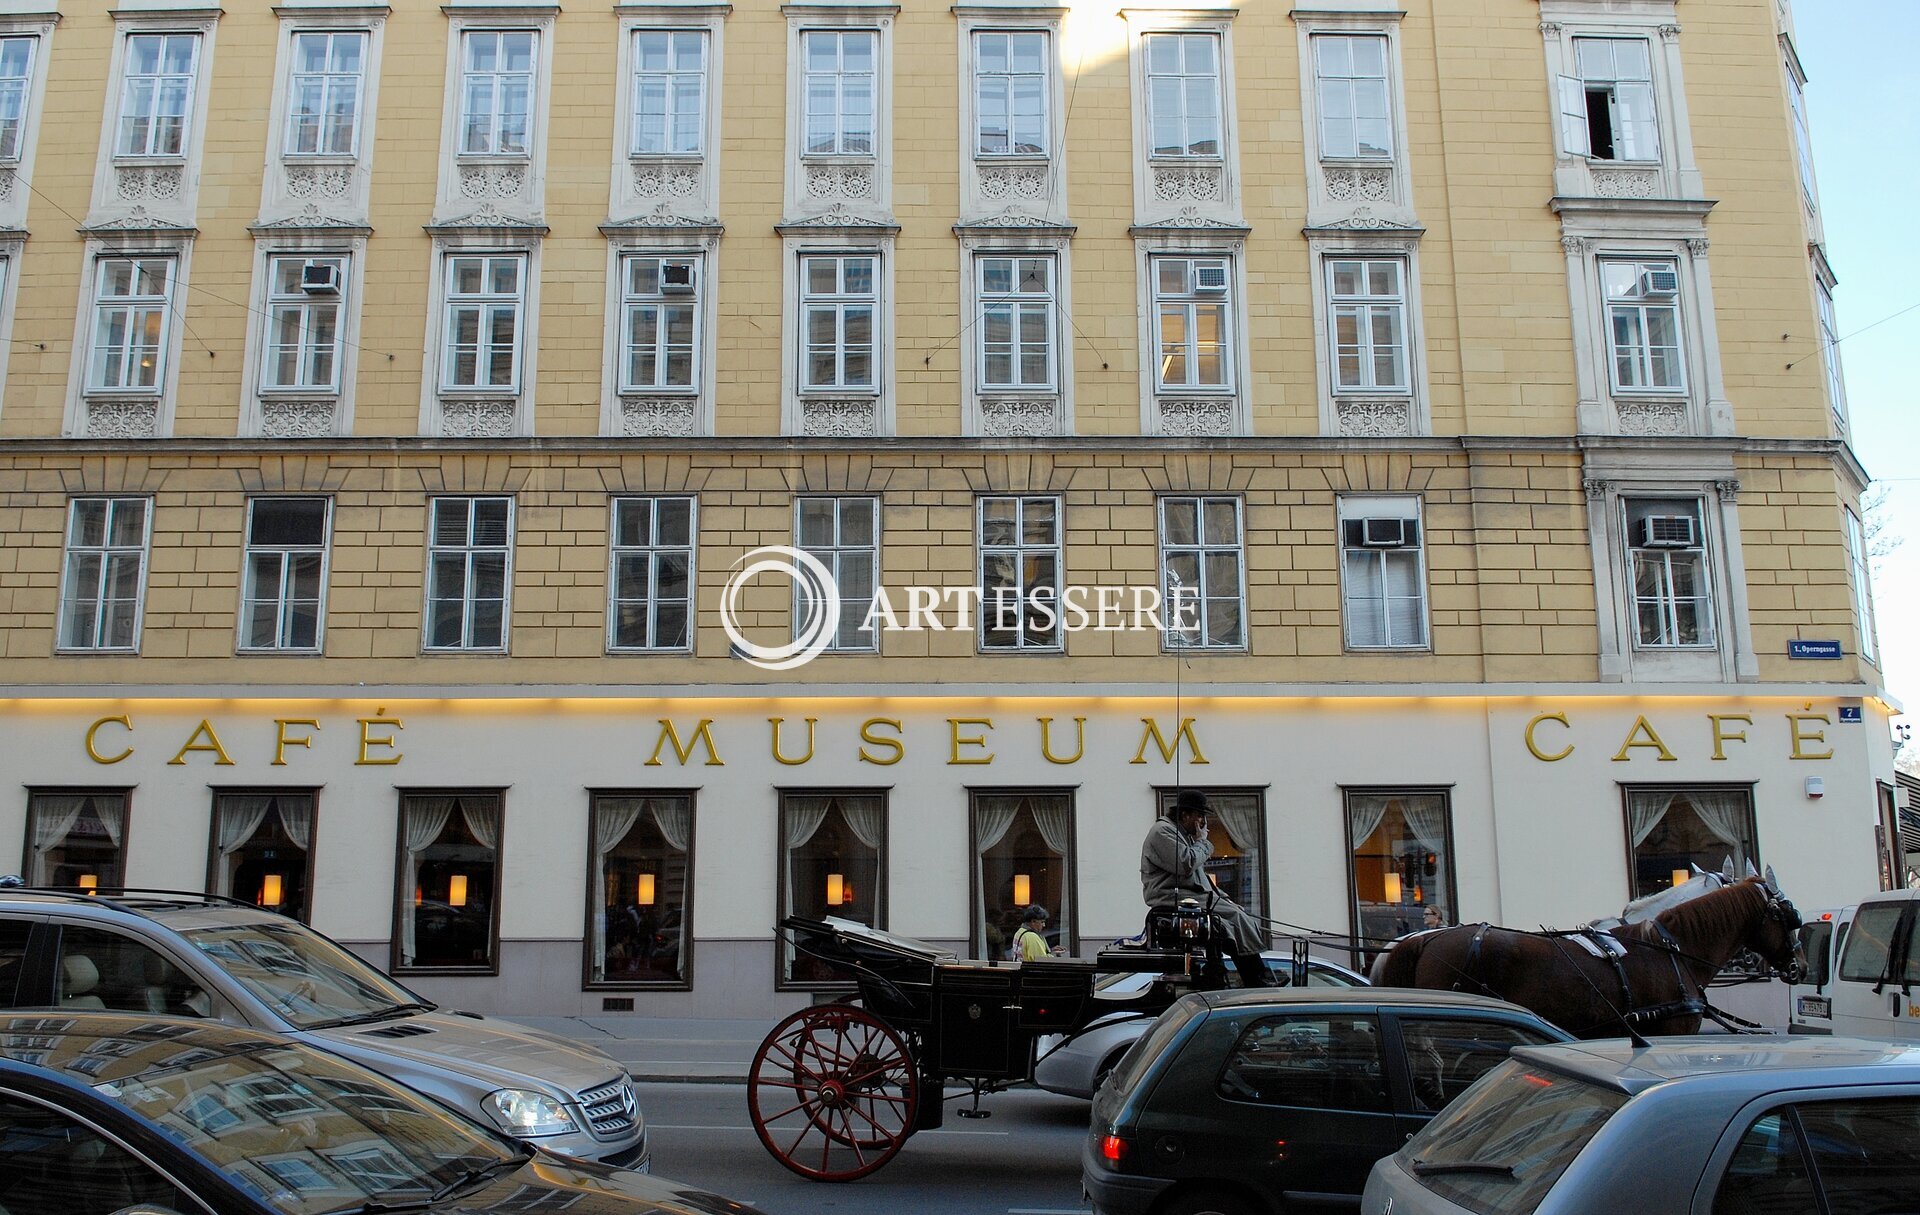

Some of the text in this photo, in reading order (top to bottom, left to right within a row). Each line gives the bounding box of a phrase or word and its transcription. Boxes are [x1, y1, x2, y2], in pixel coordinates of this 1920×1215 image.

[1802, 645, 1836, 653] Operngasse
[1846, 708, 1853, 717] 7
[86, 707, 1210, 767] CAFÉ MUSEUM
[1525, 702, 1835, 762] CAFÉ
